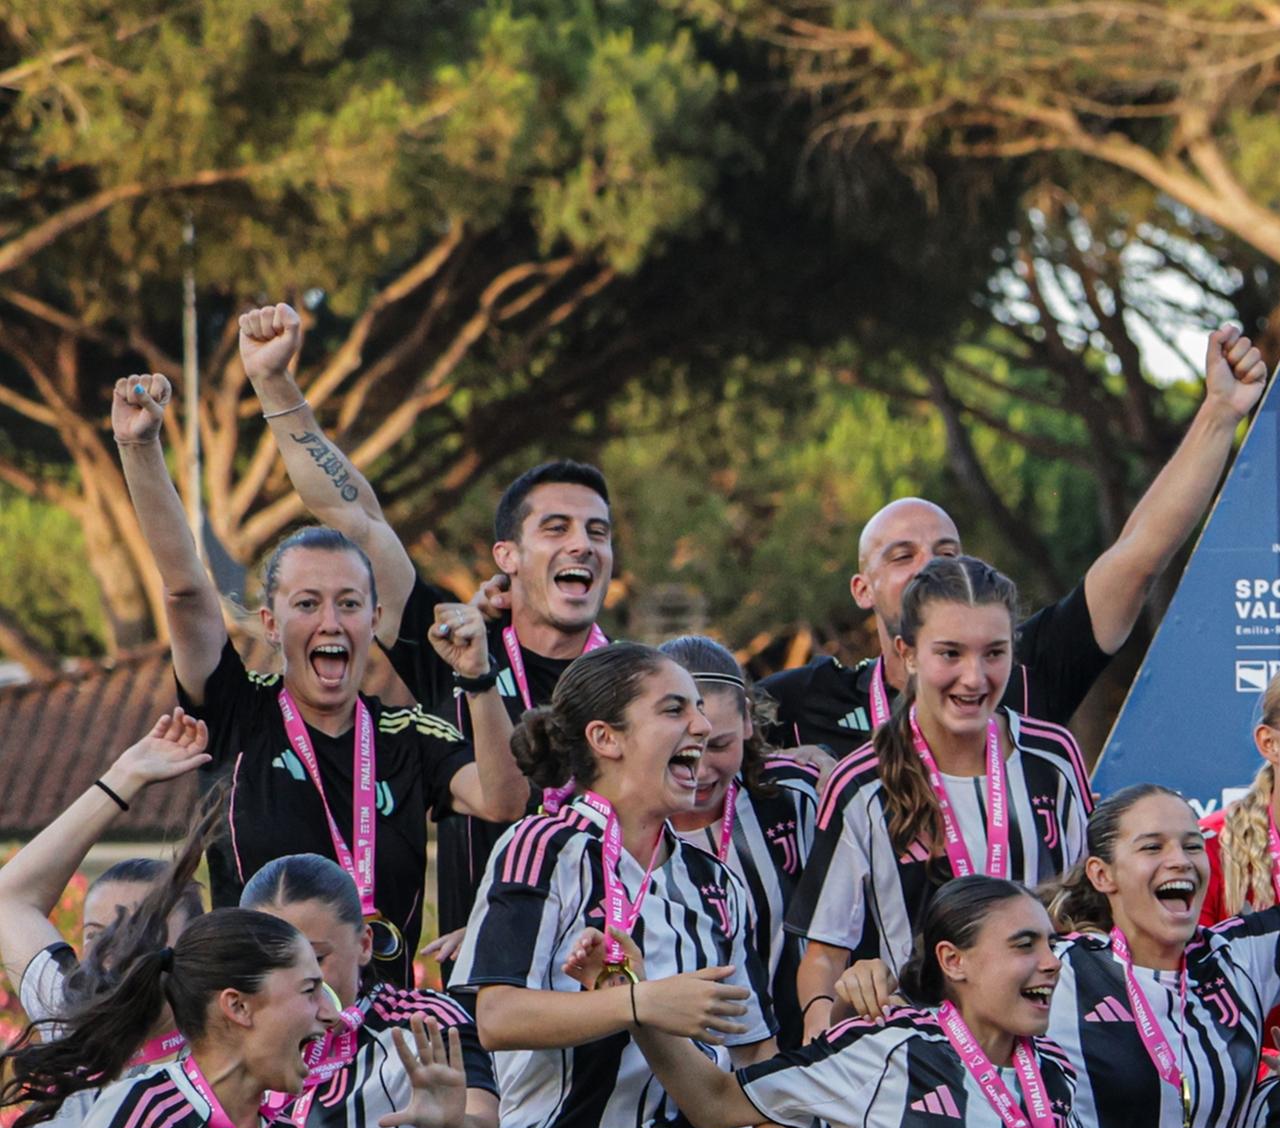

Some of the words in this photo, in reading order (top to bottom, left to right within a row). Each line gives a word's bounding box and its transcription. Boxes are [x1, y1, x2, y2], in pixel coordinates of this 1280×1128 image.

[361, 806, 370, 823] TIM
[992, 844, 1001, 860] TIM
[948, 1020, 967, 1048] UNDER
[1029, 1081, 1047, 1119] FINALI
